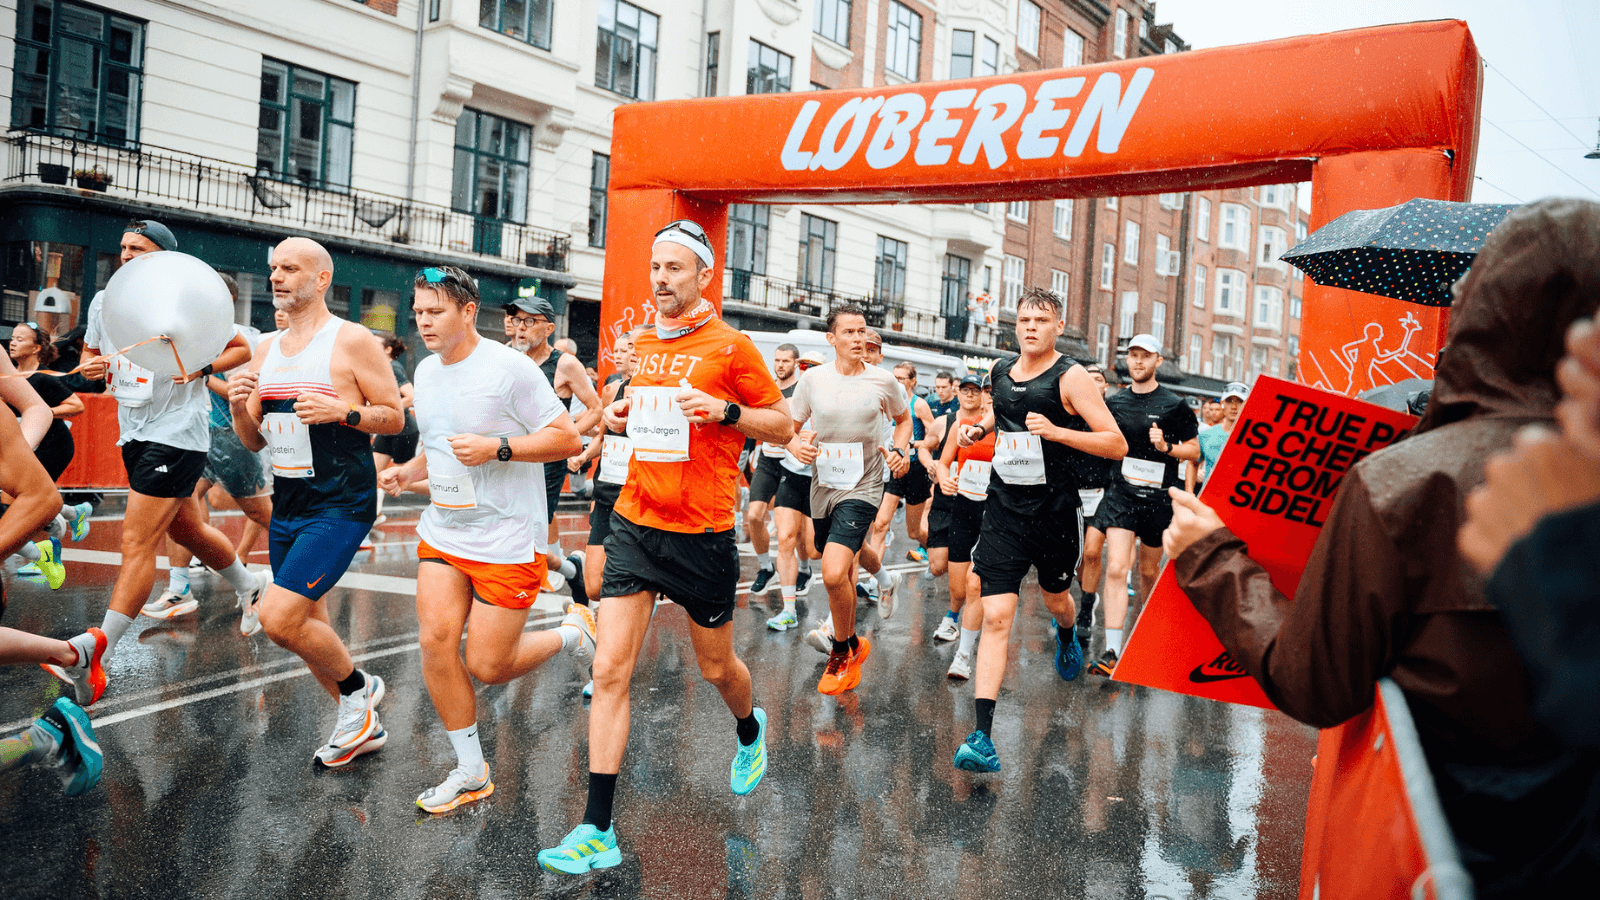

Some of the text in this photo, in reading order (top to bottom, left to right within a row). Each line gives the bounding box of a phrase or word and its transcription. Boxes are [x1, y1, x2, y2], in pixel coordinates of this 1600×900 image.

[780, 67, 1155, 171] LØBEREN
[1273, 394, 1367, 444] TRUE
[632, 424, 680, 437] Hans-Jørgen
[1235, 419, 1274, 449] IS
[270, 445, 296, 454] ostein
[832, 466, 846, 475] Roy
